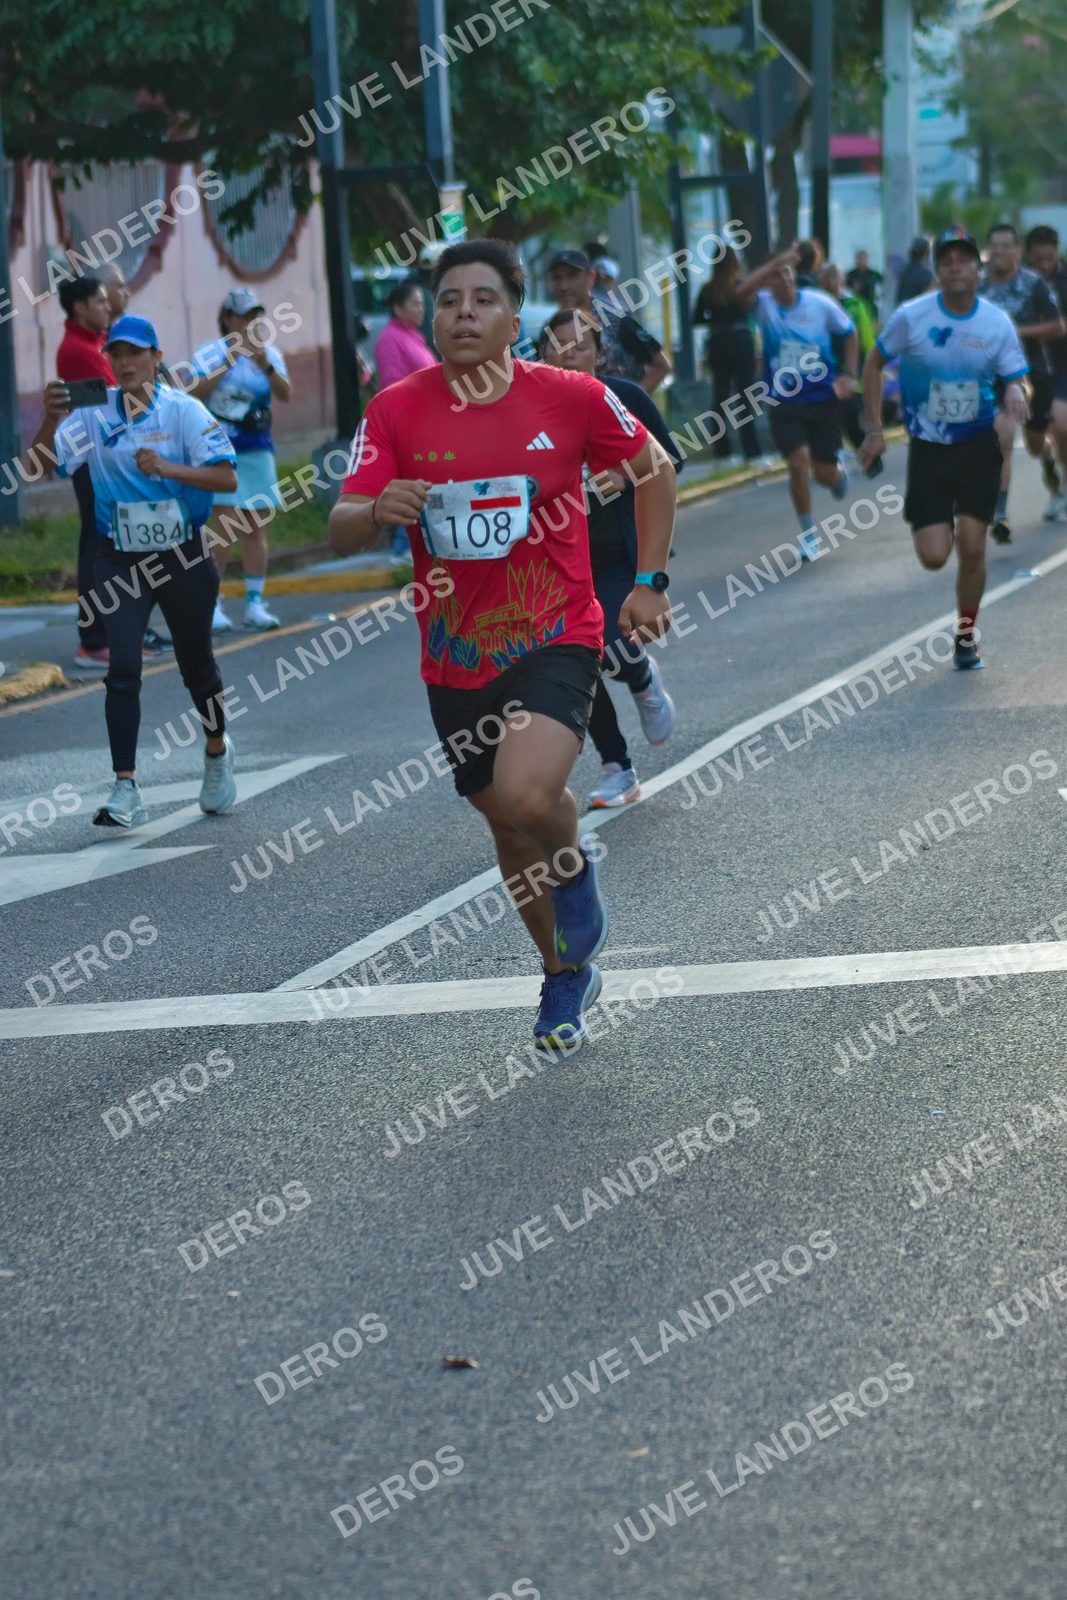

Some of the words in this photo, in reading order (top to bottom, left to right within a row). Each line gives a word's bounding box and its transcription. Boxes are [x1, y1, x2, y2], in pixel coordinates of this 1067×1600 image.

[936, 399, 973, 417] 537
[123, 521, 183, 545] 1384
[446, 511, 511, 549] 108
